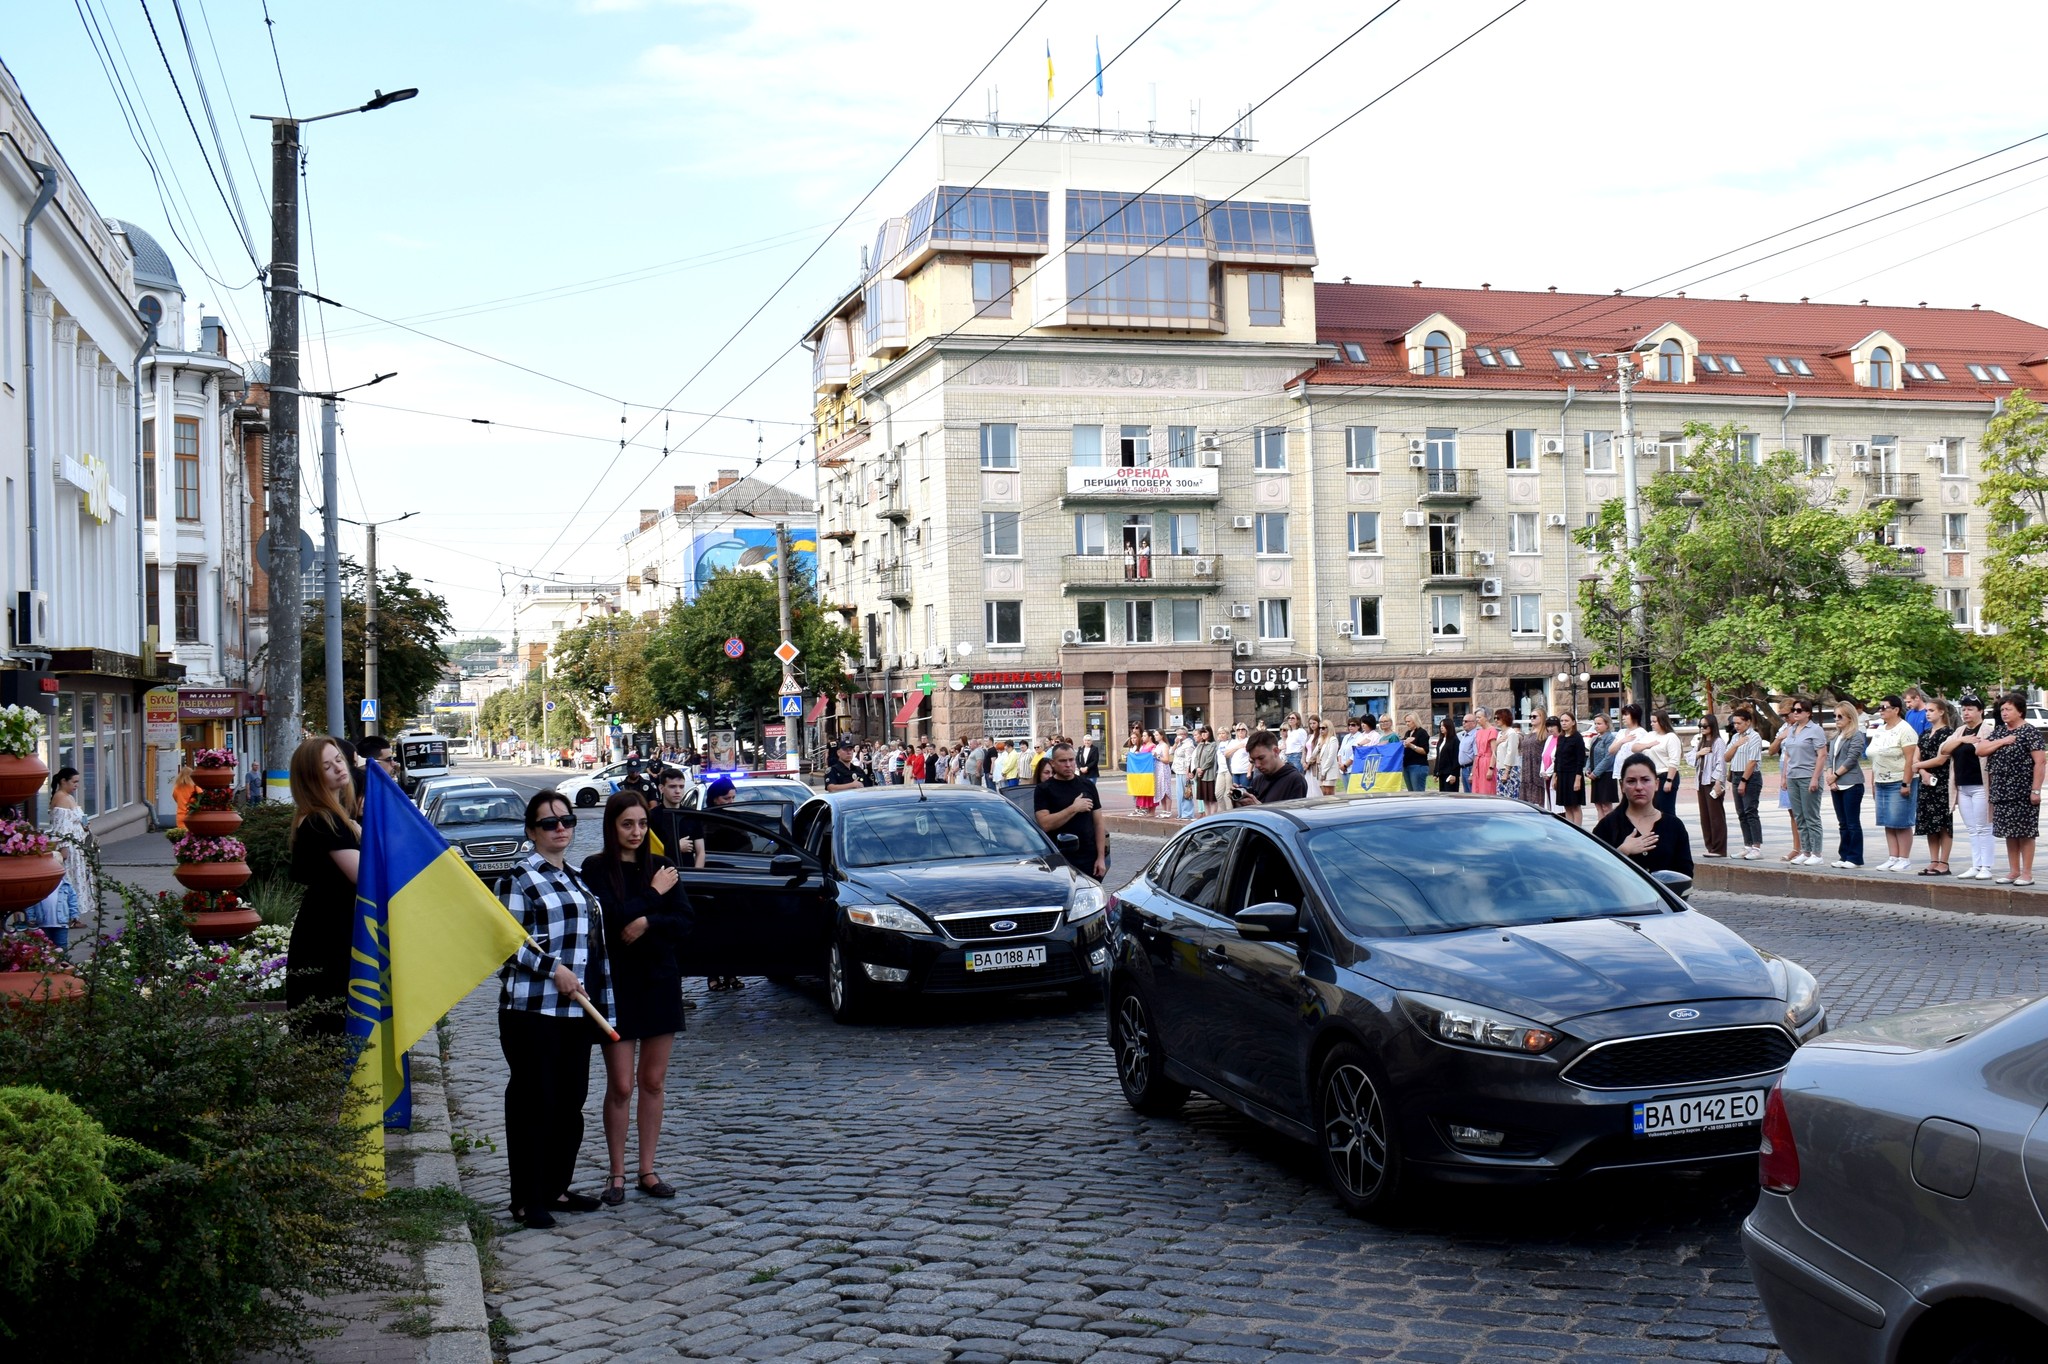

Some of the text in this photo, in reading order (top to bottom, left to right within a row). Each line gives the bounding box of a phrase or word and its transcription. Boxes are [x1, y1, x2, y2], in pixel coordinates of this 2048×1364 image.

[1117, 469, 1169, 479] ОРЕНДА
[1084, 478, 1128, 487] ПЕРШИЙ
[1131, 479, 1172, 487] ПОВЕРХ
[1235, 668, 1307, 684] GOGOL
[150, 696, 175, 705] БУКИ
[984, 718, 1029, 728] АПТЕКА
[419, 743, 430, 754] 21
[995, 950, 1023, 964] 0188
[1676, 1010, 1693, 1018] Ford
[1680, 1099, 1725, 1124] 0142
[1634, 1122, 1643, 1130] UA
